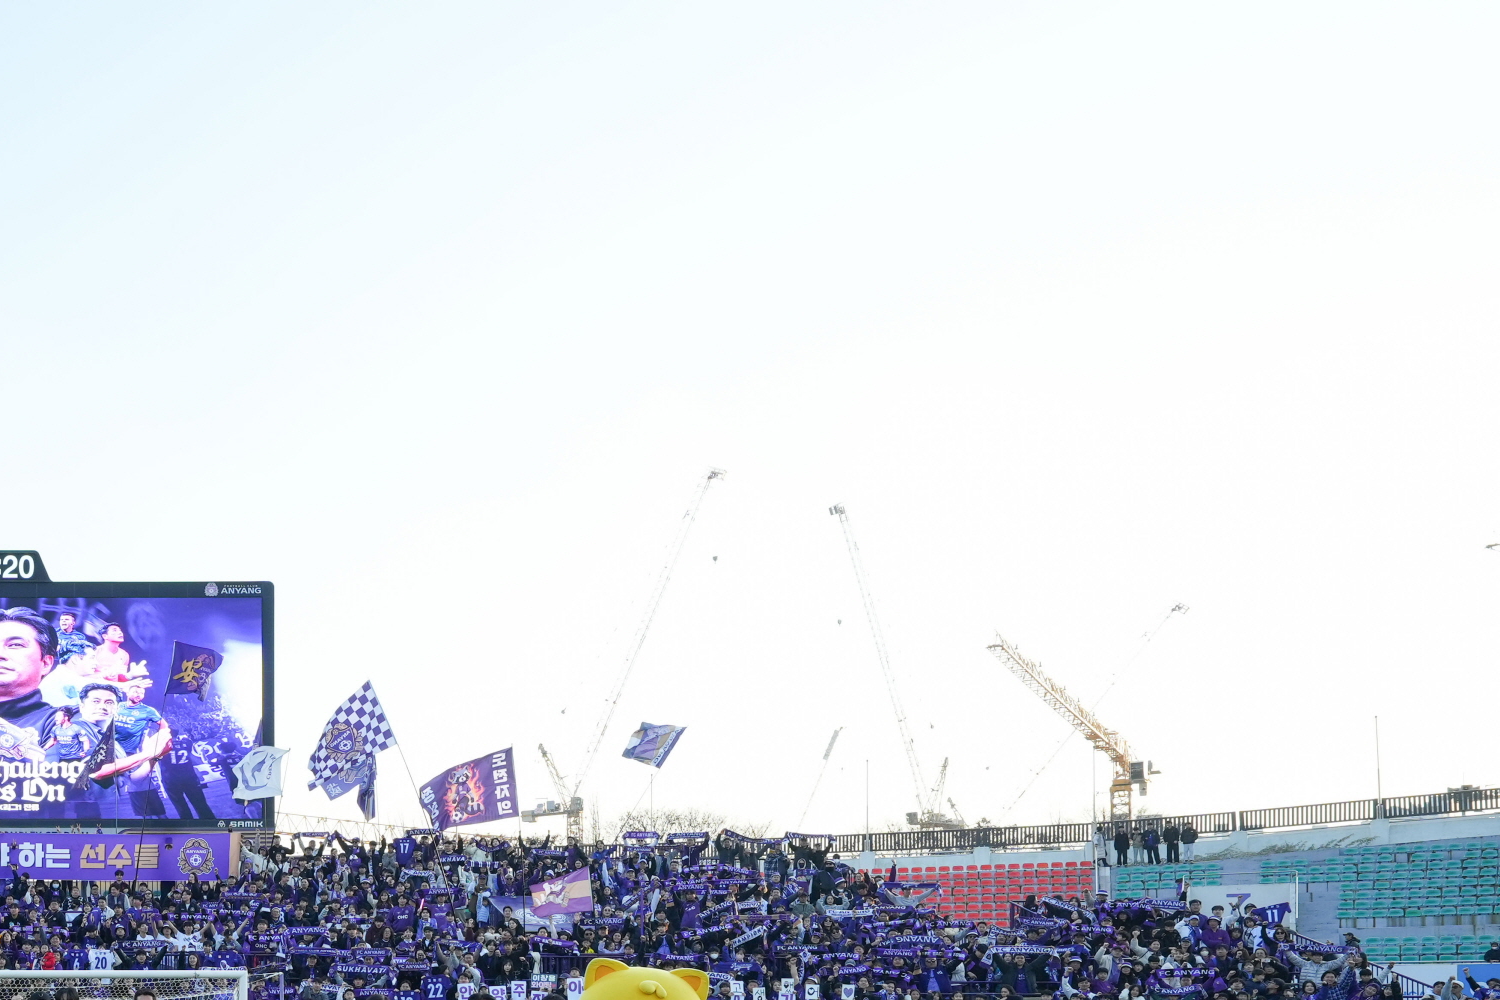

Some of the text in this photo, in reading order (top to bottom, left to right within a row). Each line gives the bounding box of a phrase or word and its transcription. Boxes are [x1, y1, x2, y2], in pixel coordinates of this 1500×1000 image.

[21, 778, 65, 802] On
[400, 844, 409, 853] 17
[18, 842, 71, 868] 하는
[80, 842, 160, 869] 선수들
[1266, 910, 1278, 923] 11
[695, 925, 731, 935] ANYANG
[1306, 945, 1343, 953] ANYANG
[95, 956, 108, 969] 20
[427, 984, 444, 998] 22
[460, 985, 473, 1000] 안
[513, 983, 525, 997] 주
